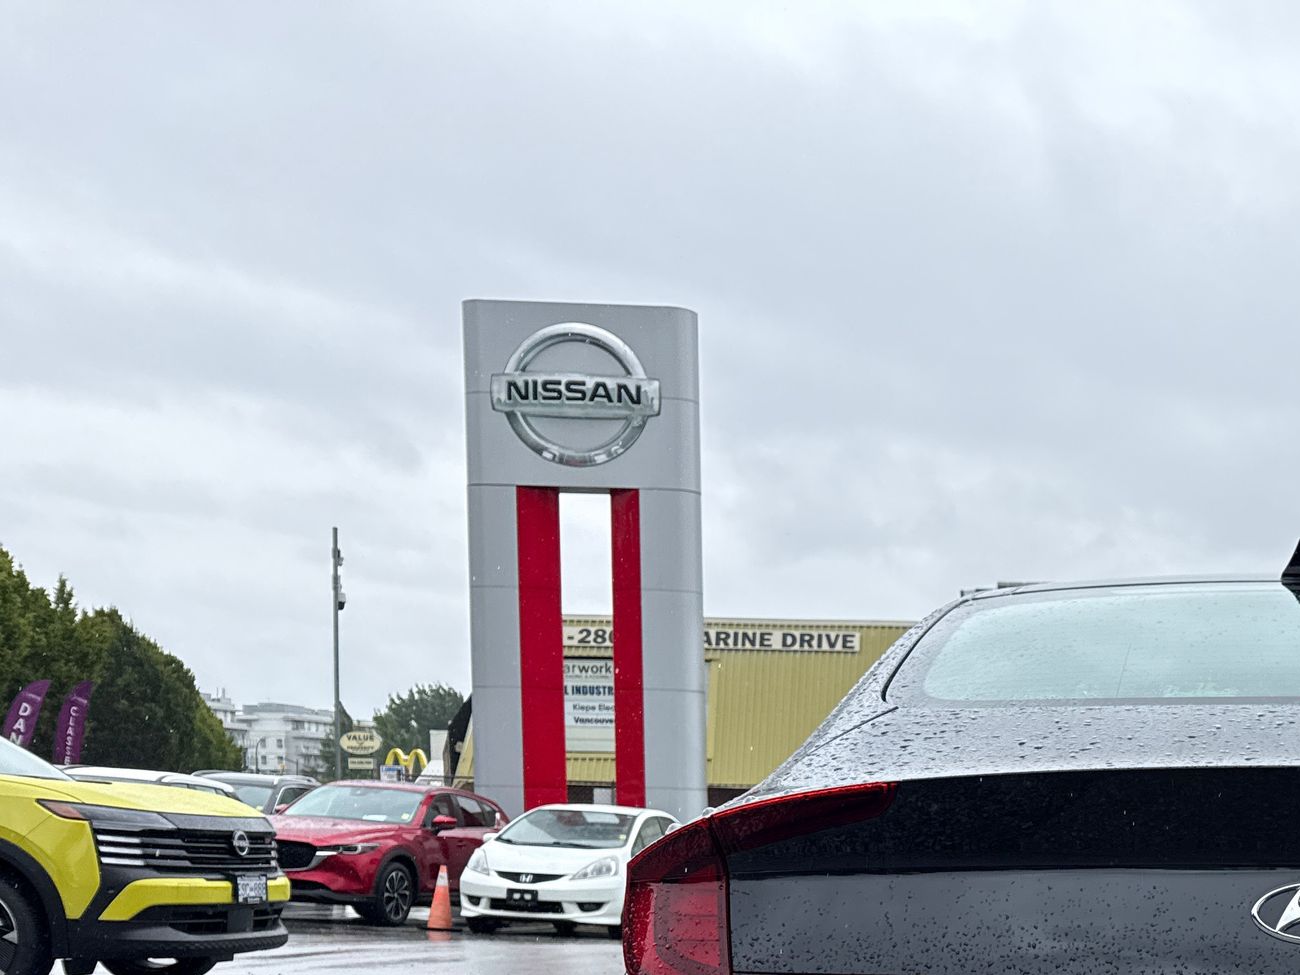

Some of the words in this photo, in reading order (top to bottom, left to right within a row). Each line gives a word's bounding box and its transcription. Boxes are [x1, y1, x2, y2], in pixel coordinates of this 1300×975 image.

[506, 379, 642, 405] NISSAN
[781, 633, 856, 649] DRIVE
[346, 734, 375, 742] VALUE
